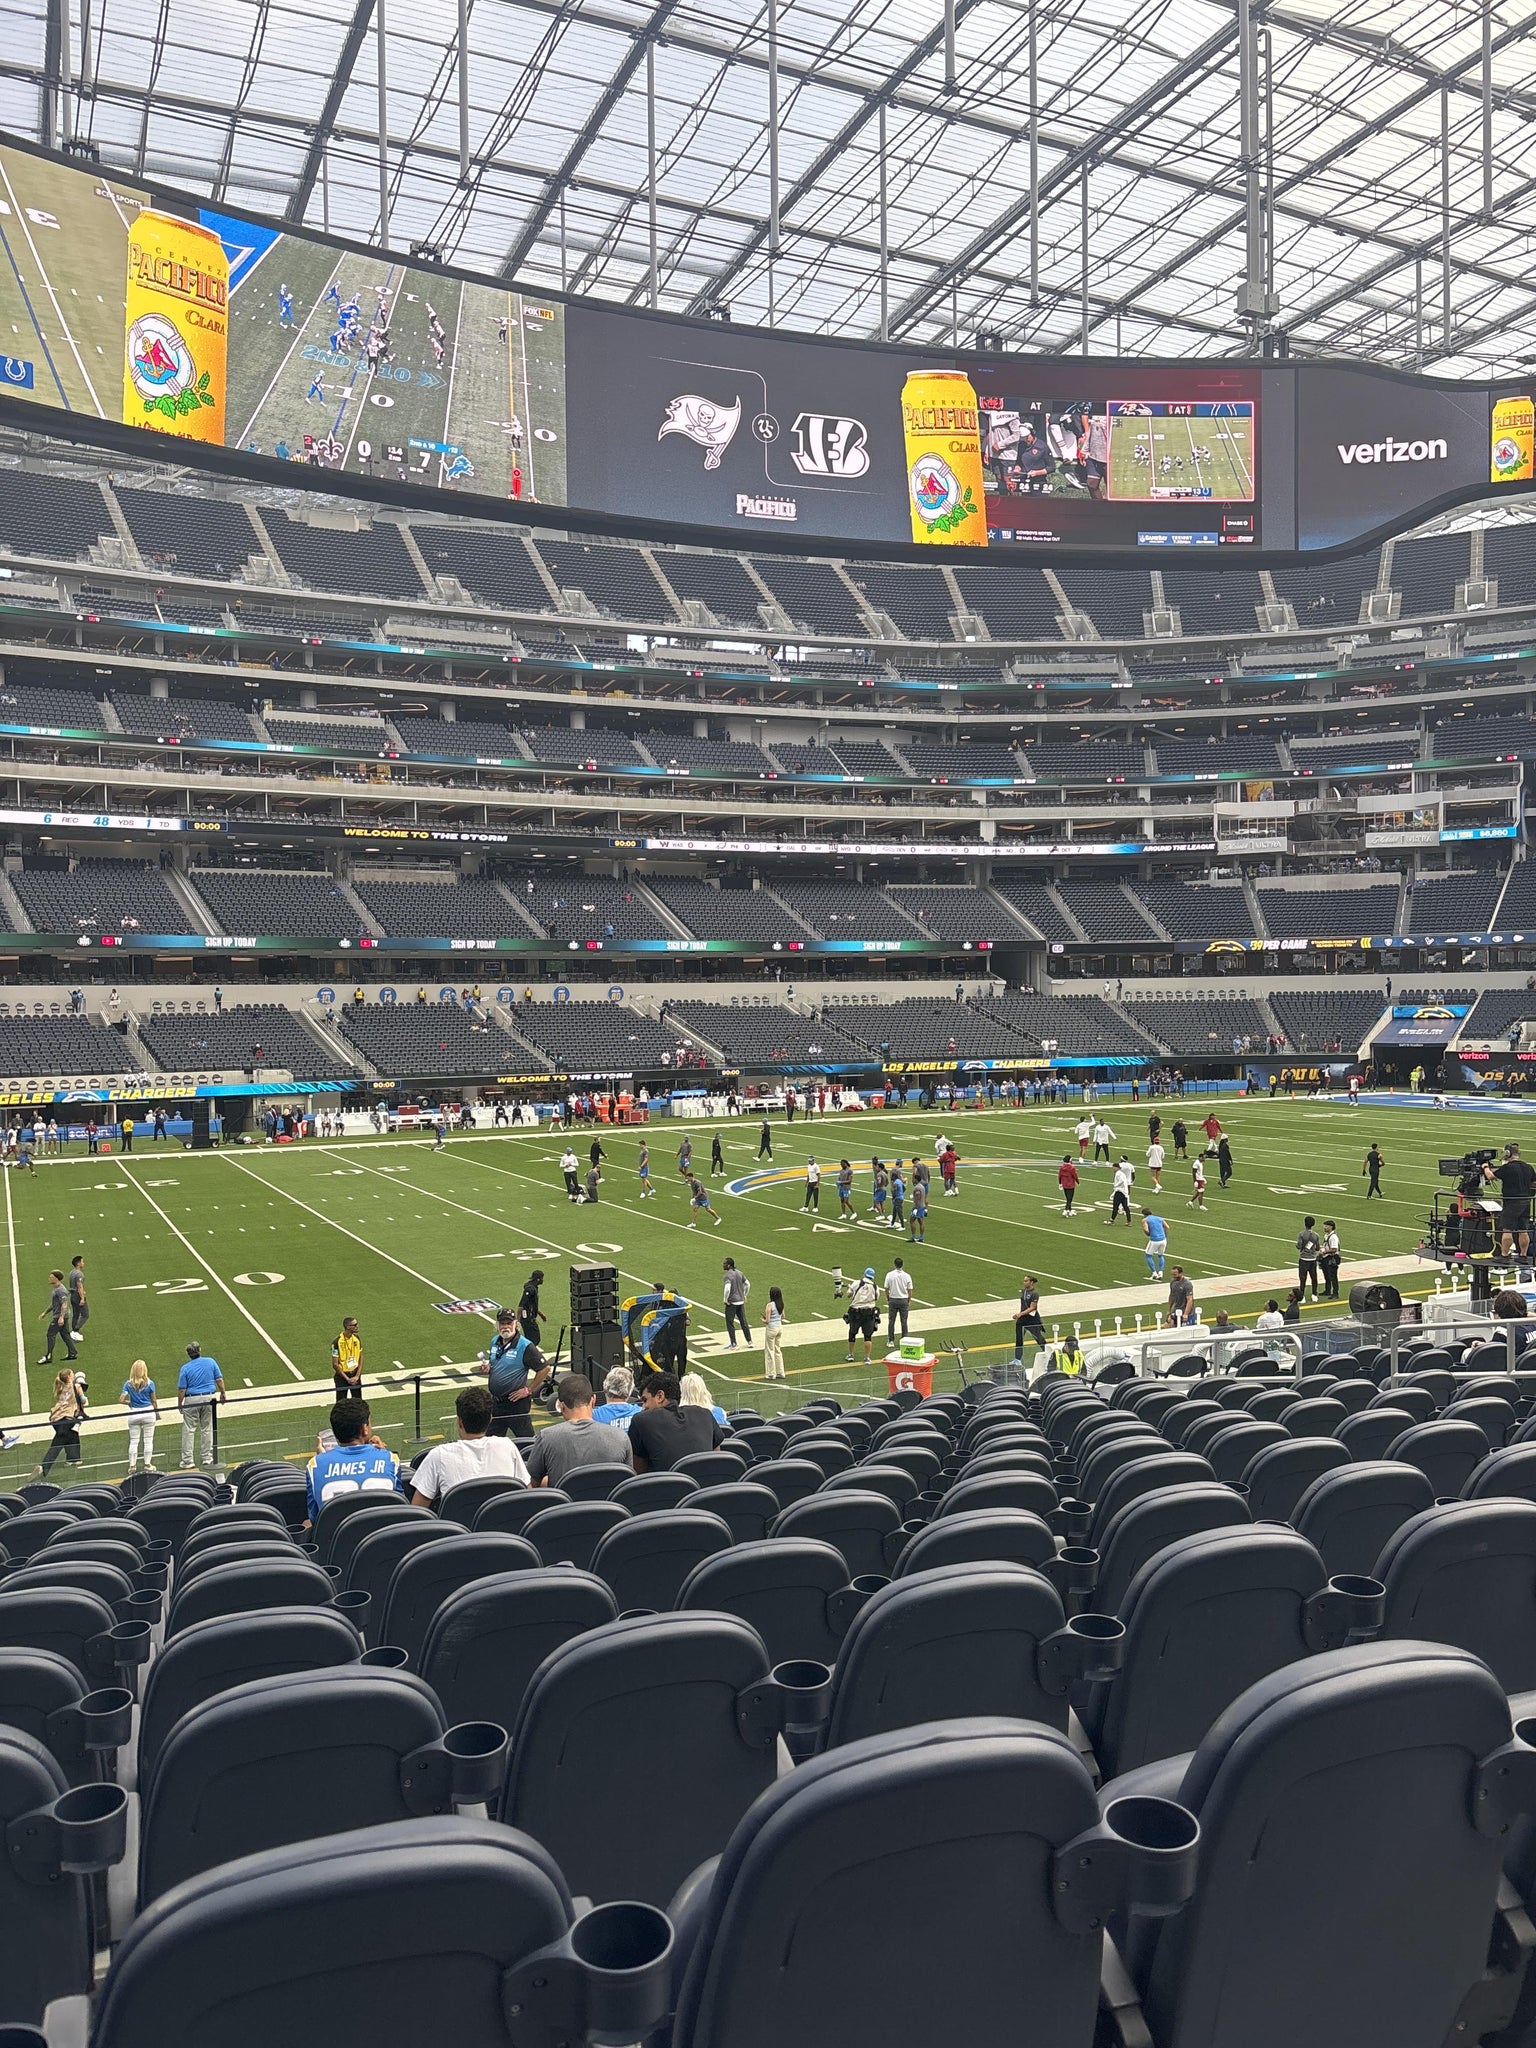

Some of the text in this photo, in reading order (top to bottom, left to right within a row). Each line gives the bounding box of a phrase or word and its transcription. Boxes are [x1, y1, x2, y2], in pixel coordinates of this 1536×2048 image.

[1030, 402, 1042, 411] AT
[1174, 405, 1186, 415] AT
[1337, 437, 1448, 464] verizon
[419, 451, 431, 467] 7
[736, 494, 797, 518] PACIFICO
[43, 813, 52, 824] 6
[92, 816, 110, 826] 48
[146, 818, 151, 828] 1
[193, 822, 221, 831] 90:00
[343, 828, 508, 843] WELCOME TO THE STORM
[614, 840, 637, 848] 90:00
[1142, 844, 1172, 852] AROUND
[1186, 843, 1216, 851] LEAGUE
[114, 937, 123, 946] TV
[204, 936, 257, 948] SIGN UP TODAY
[370, 939, 379, 948] TV
[450, 940, 497, 949] SIGN UP TODAY
[596, 942, 603, 950] TV
[666, 941, 708, 951] SIGN UP TODAY
[797, 942, 805, 950] TV
[863, 941, 901, 951] SIGN UP TODAY
[986, 942, 994, 950] TV
[1250, 939, 1308, 951] $39 PER GAME
[881, 1058, 1051, 1073] LOS ANGELES CHARGERS
[497, 1071, 634, 1084] WELCOME TO THE STORM
[372, 1081, 396, 1089] 90:00
[108, 1086, 198, 1101] CHARGERS
[895, 1371, 914, 1391] G
[324, 1459, 386, 1478] JAMES JR
